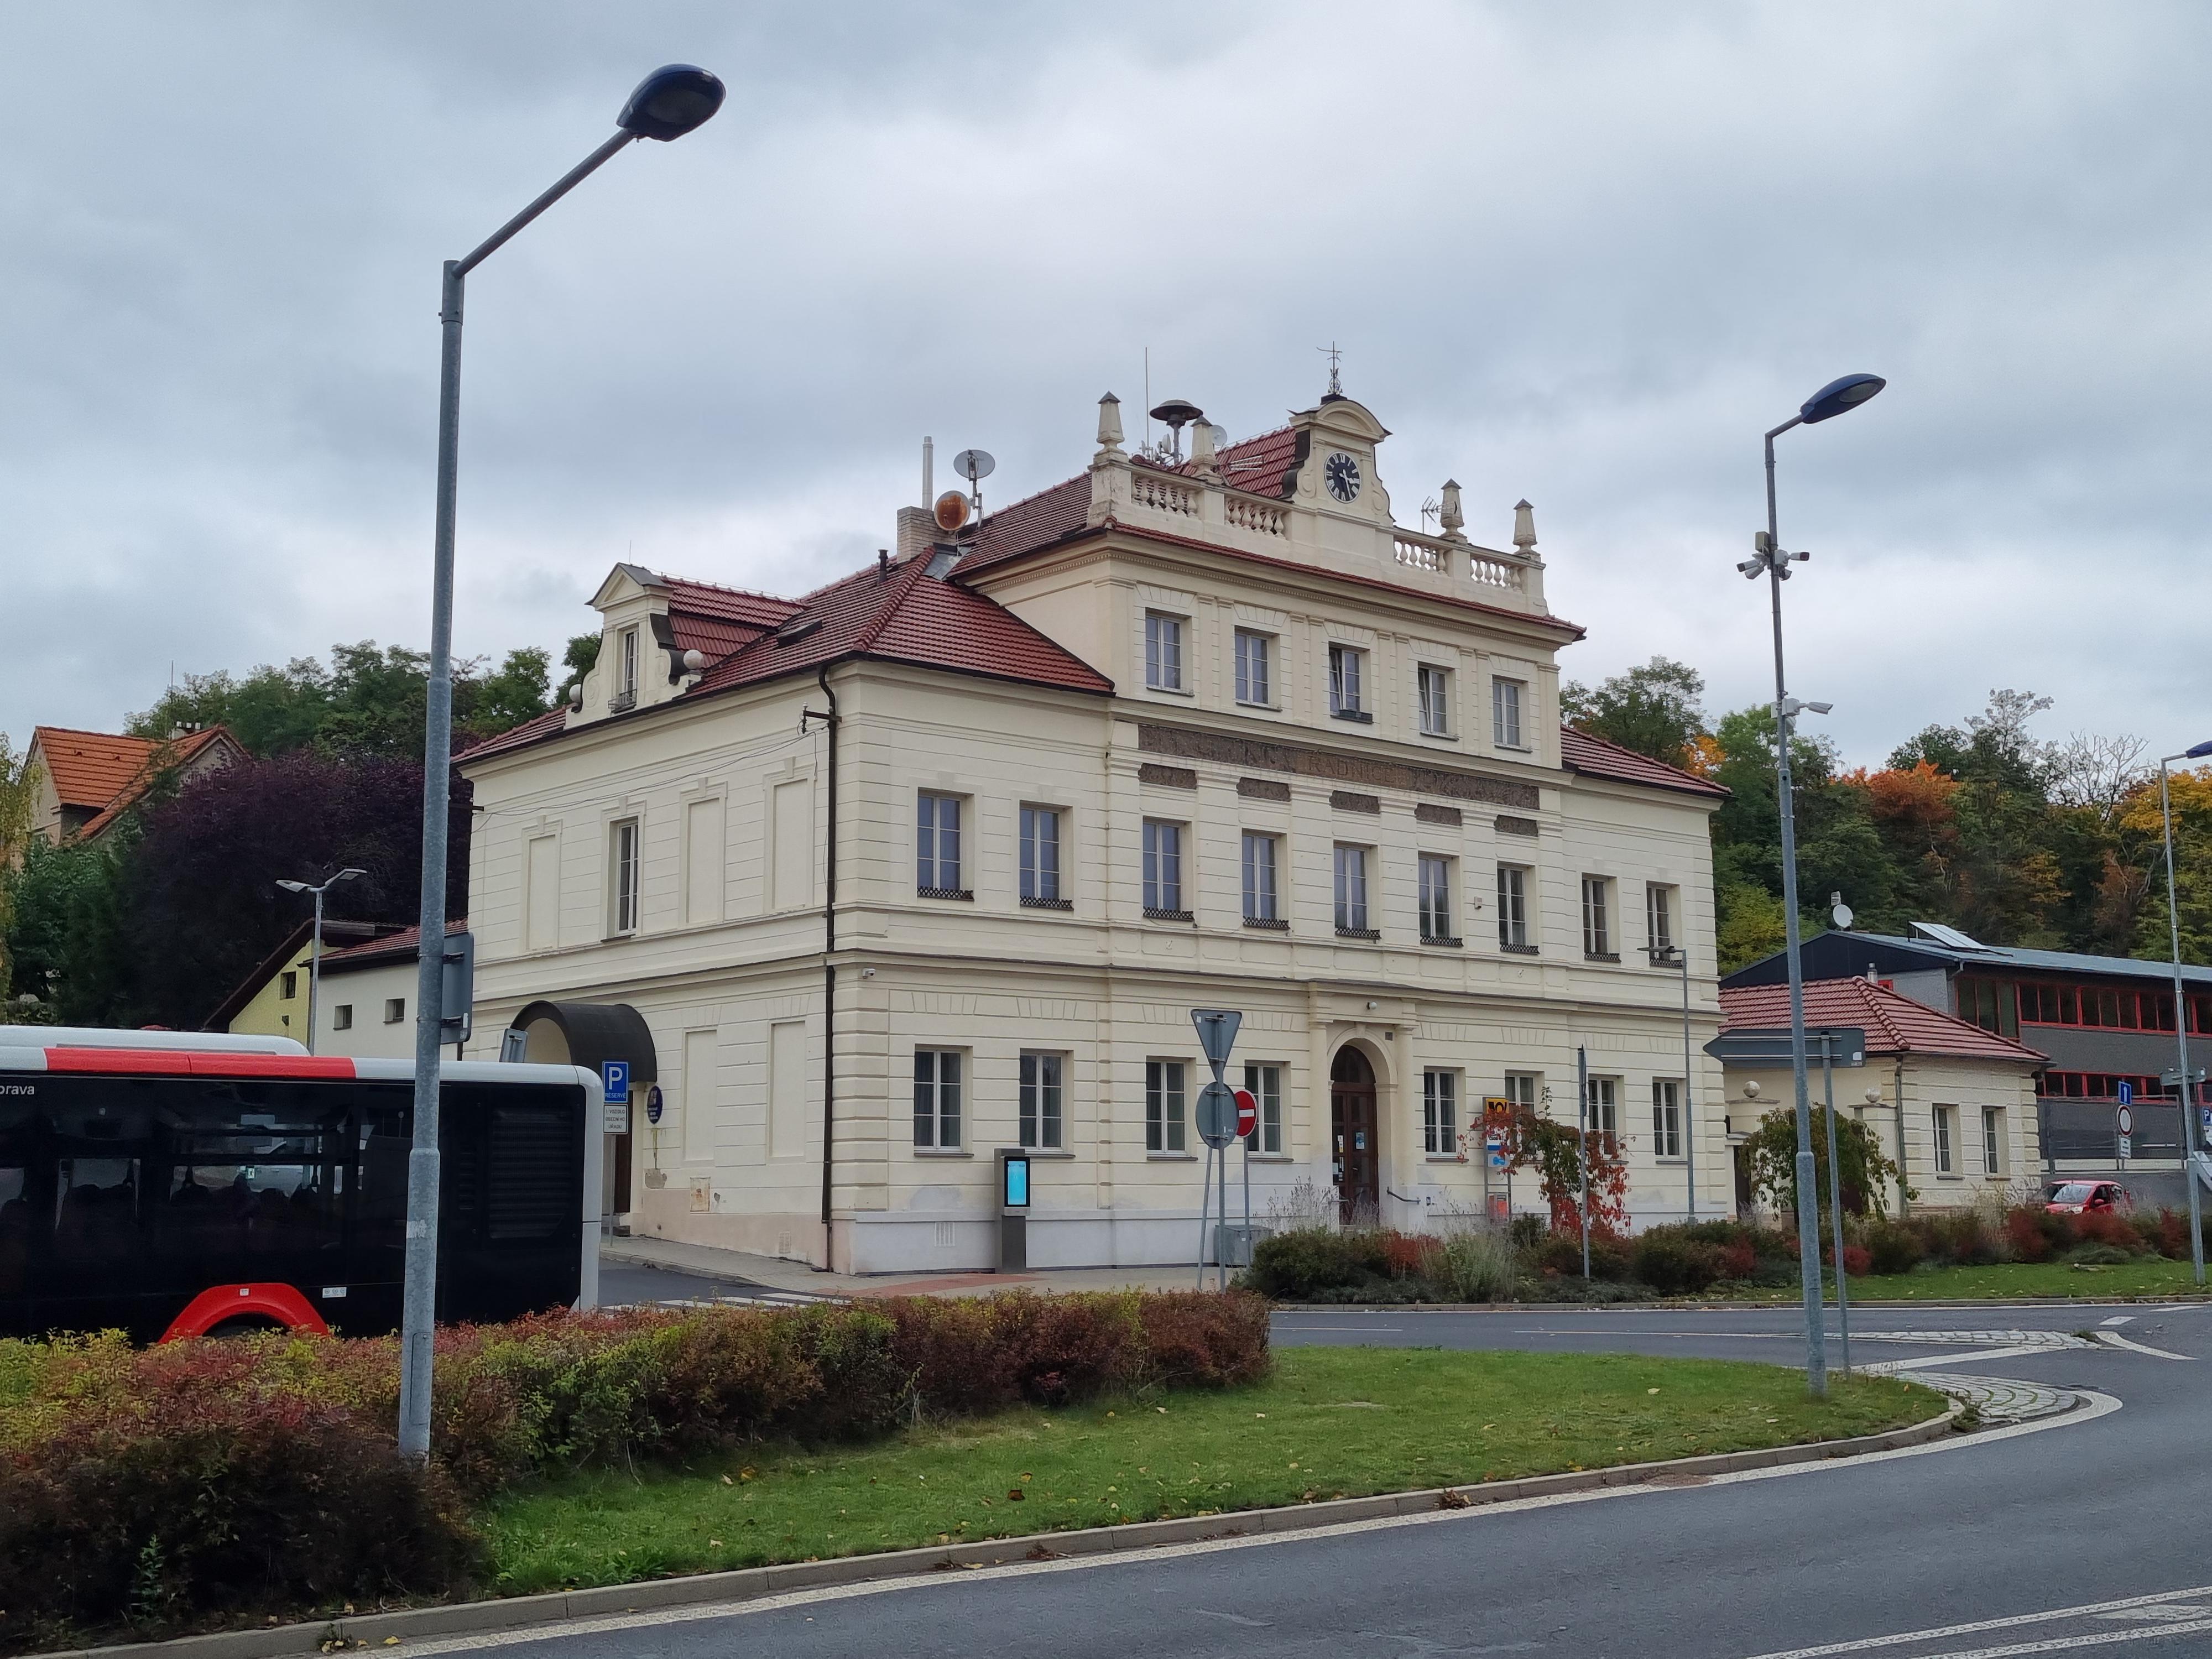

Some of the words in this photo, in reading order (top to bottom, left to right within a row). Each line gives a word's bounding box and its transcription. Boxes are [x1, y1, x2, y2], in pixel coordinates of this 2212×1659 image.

[1308, 755, 1395, 783] RADNICE
[609, 1067, 623, 1090] P
[2204, 1109, 2210, 1120] P
